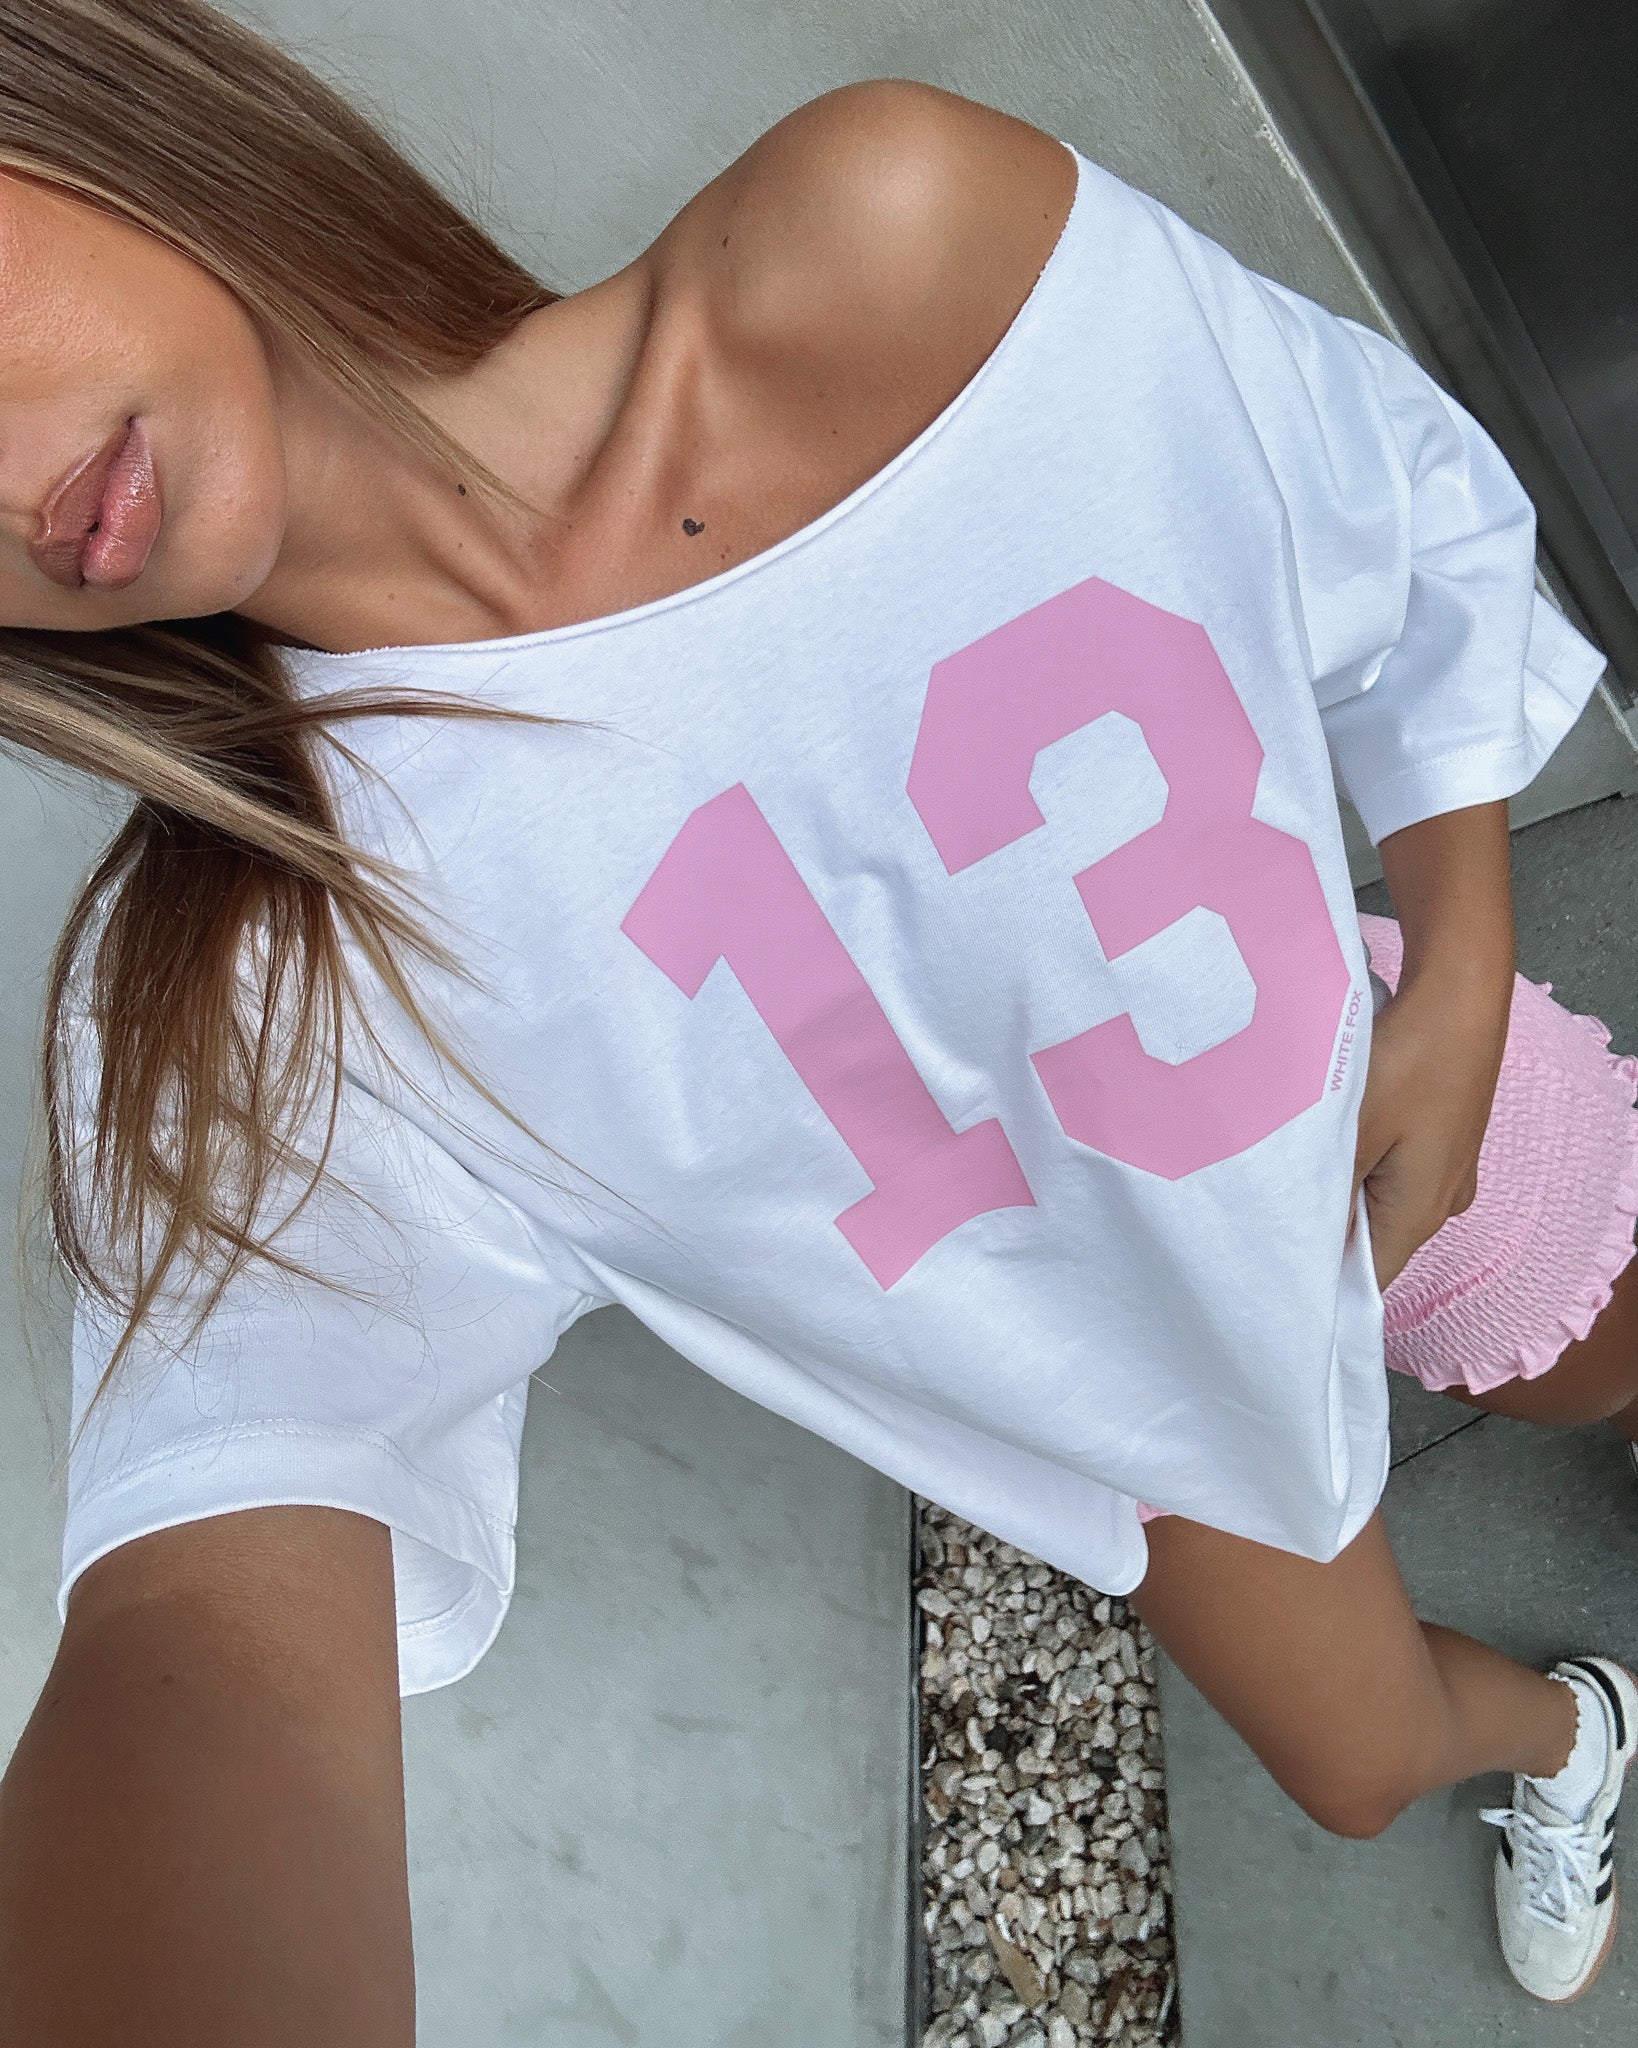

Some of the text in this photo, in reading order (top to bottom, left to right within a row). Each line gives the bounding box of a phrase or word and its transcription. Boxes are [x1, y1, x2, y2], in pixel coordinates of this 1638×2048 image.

[621, 577, 1351, 1291] 13
[1330, 990, 1363, 1091] WHITE FOX
